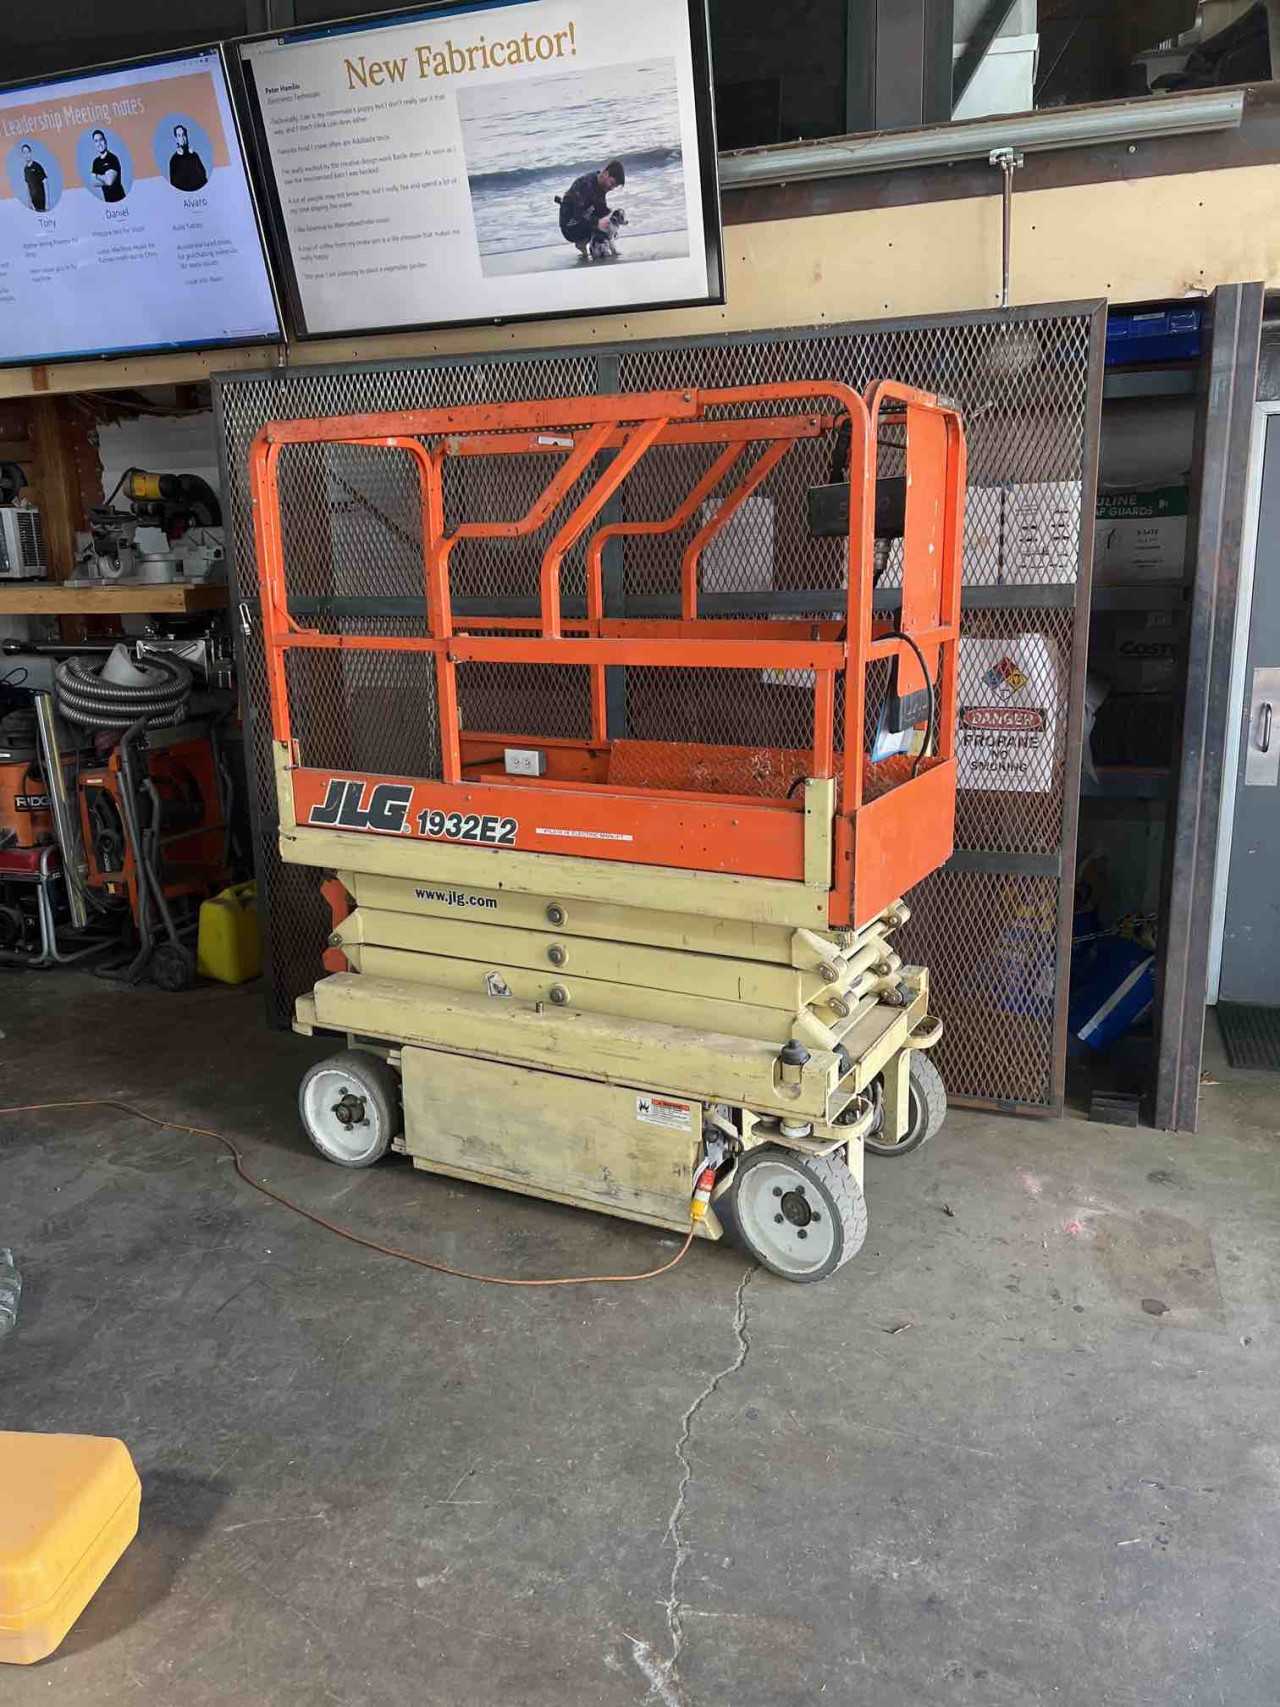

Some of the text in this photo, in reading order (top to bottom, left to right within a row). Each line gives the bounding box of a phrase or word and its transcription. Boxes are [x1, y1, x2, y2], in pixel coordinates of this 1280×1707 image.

[344, 21, 577, 90] New Fabricator!
[4, 96, 145, 137] Leadership Meeting notes
[183, 198, 208, 209] Alvaro
[105, 208, 129, 219] Daniel
[38, 217, 56, 232] Tony
[972, 712, 1034, 726] DANGER
[963, 734, 1040, 749] PROPANE
[992, 750, 1008, 760] NO
[970, 761, 1028, 772] SMOKING
[309, 779, 518, 847] JLG 1932E2
[415, 887, 498, 908] www.jlg.com
